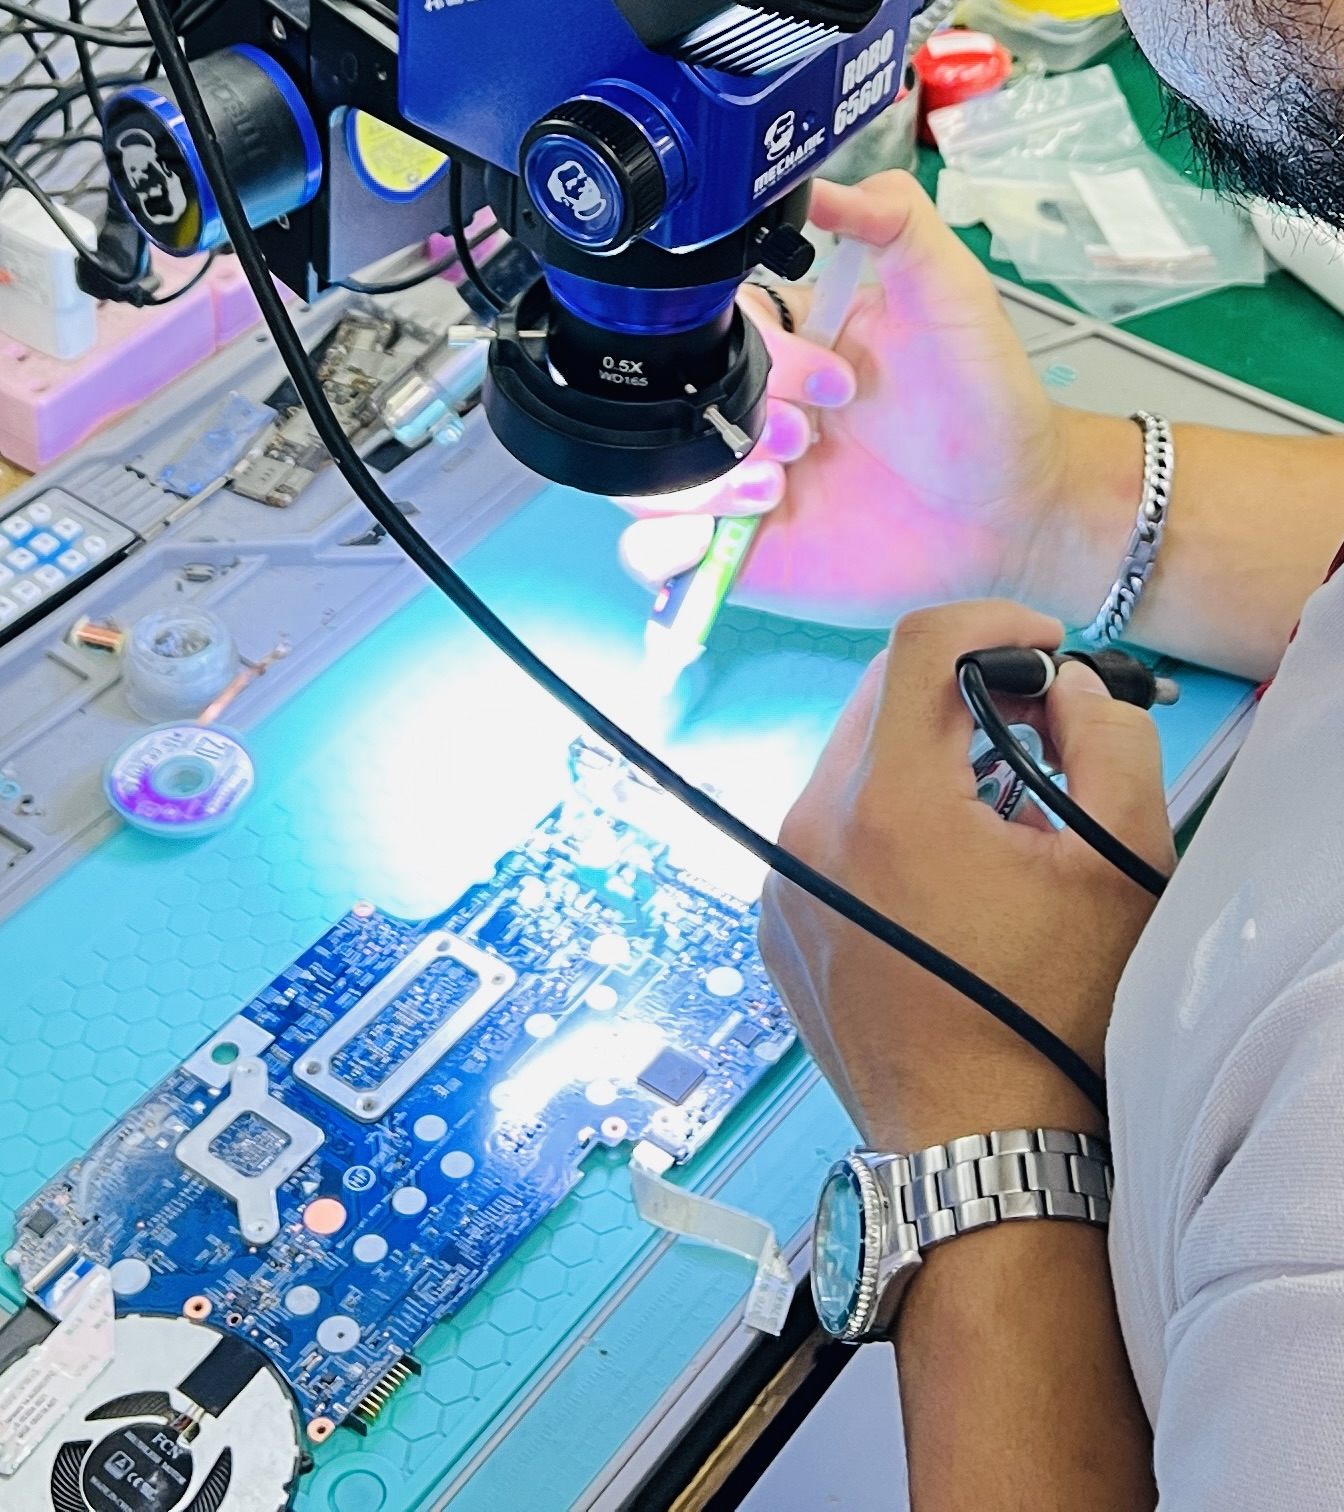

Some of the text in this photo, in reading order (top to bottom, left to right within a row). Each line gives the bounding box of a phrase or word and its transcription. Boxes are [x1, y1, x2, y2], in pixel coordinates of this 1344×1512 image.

[842, 28, 895, 95] ROBO
[833, 60, 897, 136] 6560T
[753, 126, 826, 193] MECHANIC
[602, 356, 643, 374] 0.5X
